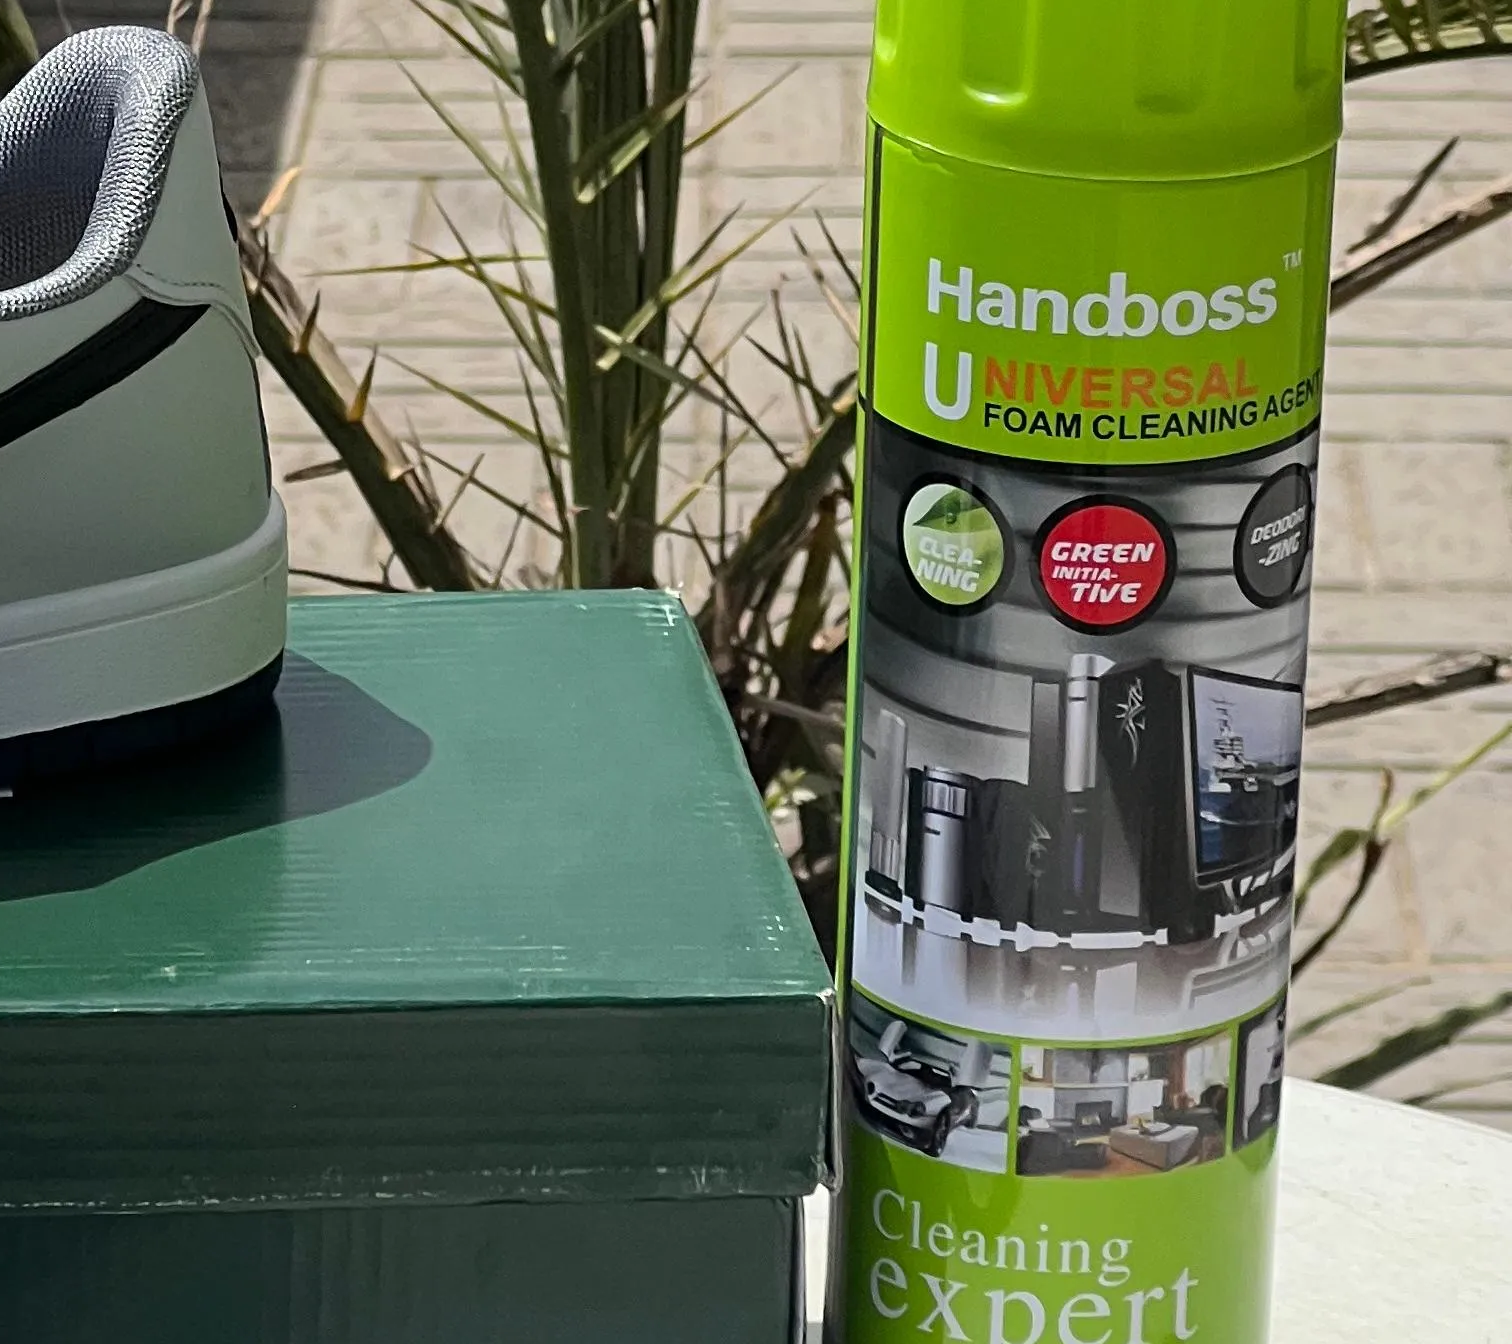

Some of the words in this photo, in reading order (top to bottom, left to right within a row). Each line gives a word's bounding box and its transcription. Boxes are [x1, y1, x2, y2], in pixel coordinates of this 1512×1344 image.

[927, 257, 1278, 338] Handboss
[984, 402, 1082, 439] FOAM
[1091, 400, 1258, 441] CLEANING
[919, 536, 983, 567] CLEA-
[1051, 542, 1155, 563] GREEN
[916, 557, 980, 593] NING
[1052, 565, 1119, 581] INITIA-
[1071, 582, 1142, 603] TIVE
[872, 1188, 1134, 1287] Cleaning
